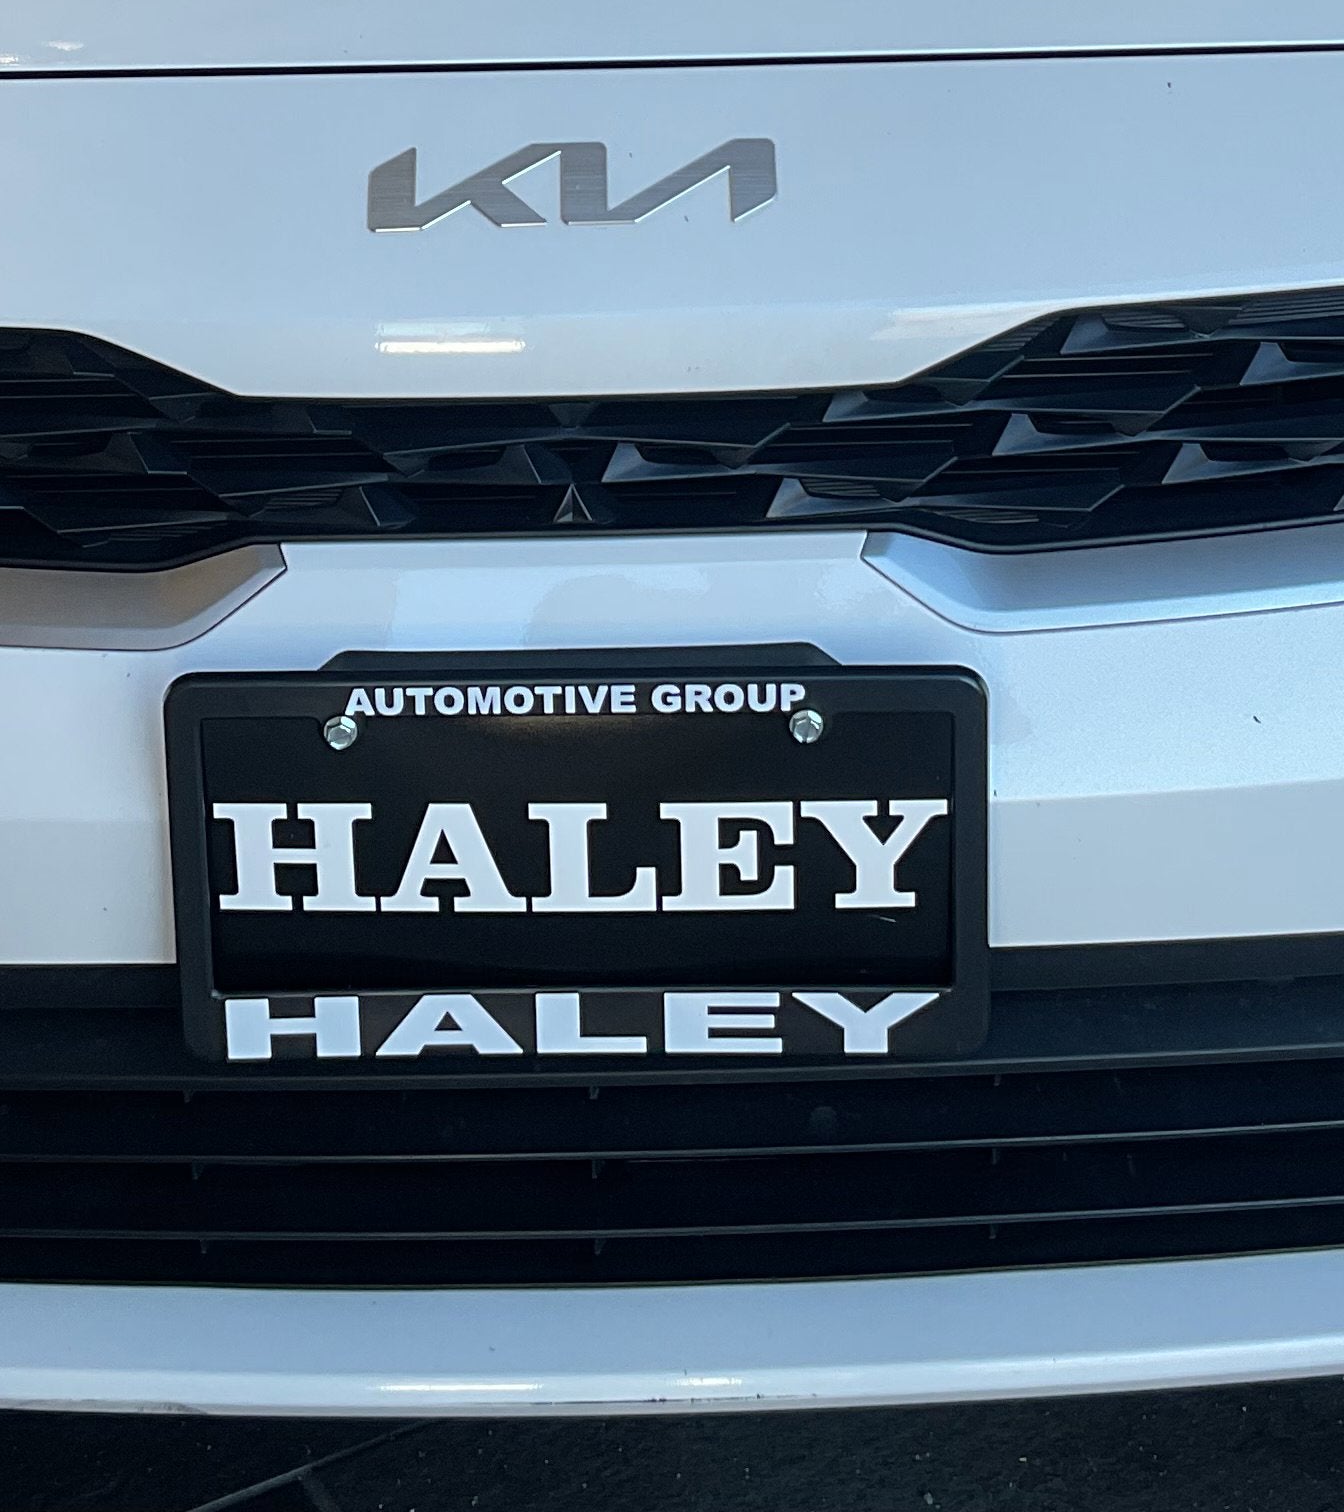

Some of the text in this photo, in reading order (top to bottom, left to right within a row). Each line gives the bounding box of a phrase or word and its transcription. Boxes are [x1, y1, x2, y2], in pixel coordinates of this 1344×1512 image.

[367, 137, 777, 232] KIA
[343, 683, 806, 717] AUTOMOTIVE GROUP
[213, 799, 948, 912] HALEY
[225, 992, 940, 1060] HALEY
